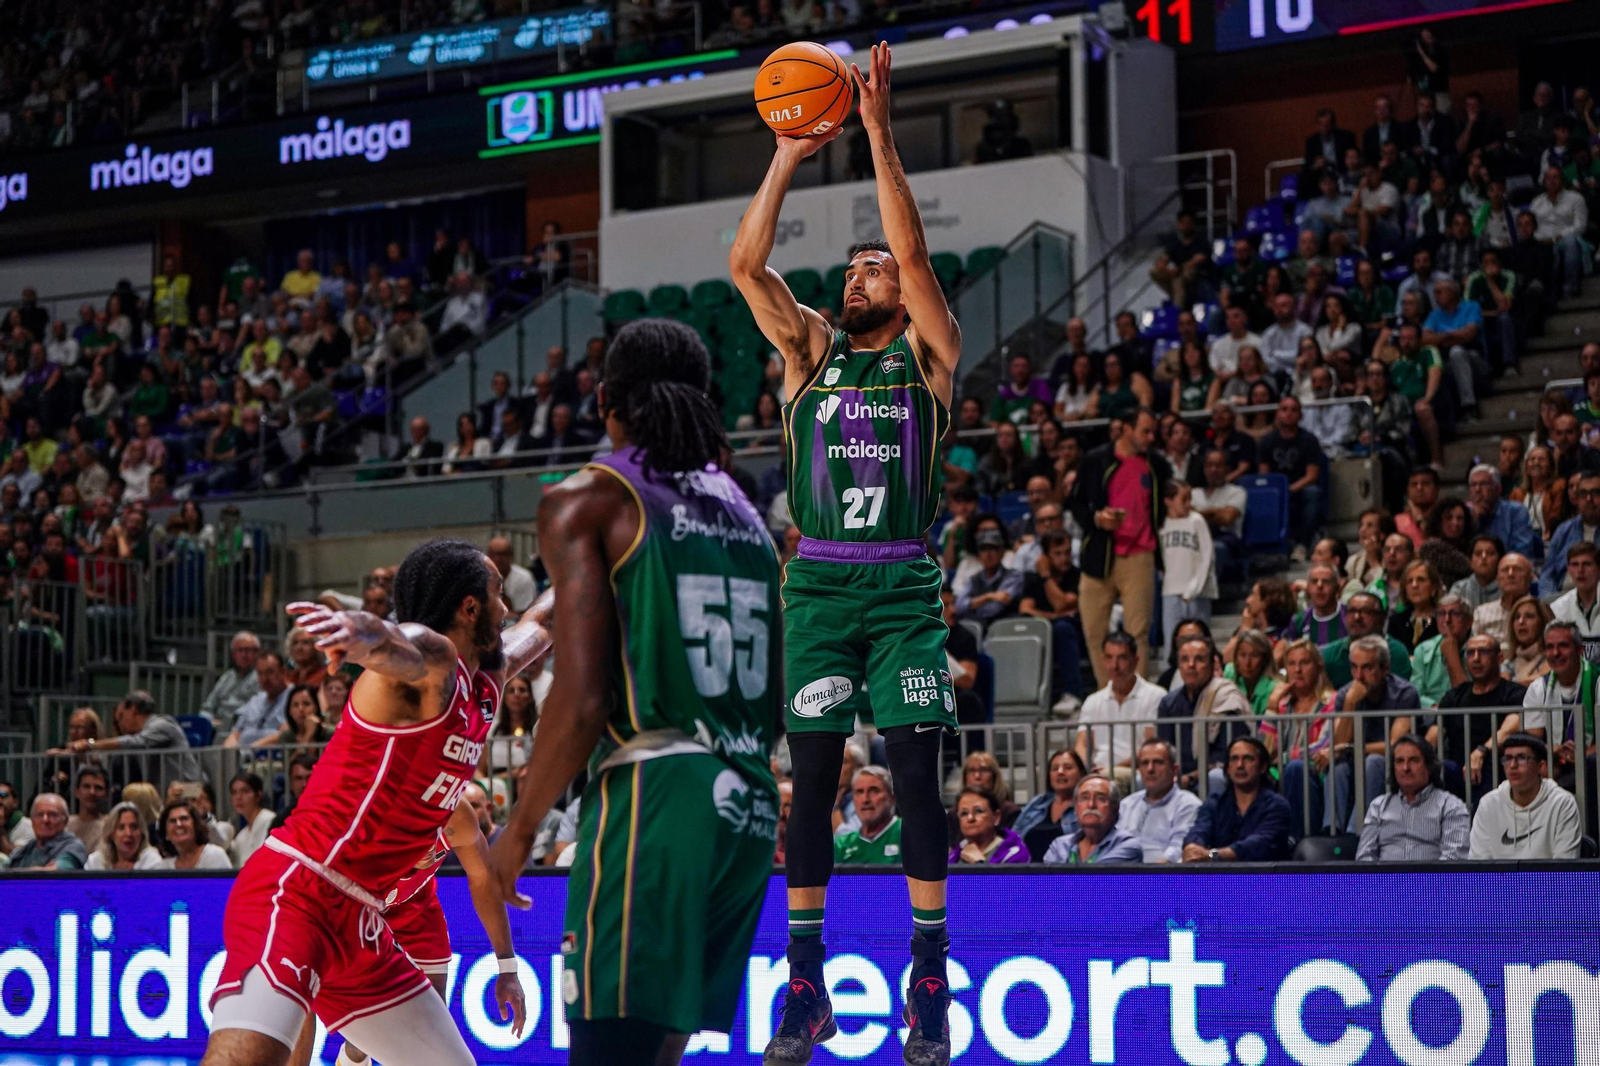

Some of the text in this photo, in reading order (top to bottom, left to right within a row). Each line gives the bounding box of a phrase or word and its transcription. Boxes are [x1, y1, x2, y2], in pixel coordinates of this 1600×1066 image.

[1136, 0, 1192, 44] 11
[845, 401, 909, 424] Unicaja
[842, 486, 886, 529] 27
[676, 573, 769, 700] 55
[900, 667, 925, 678] sabor
[799, 679, 851, 712] famadesa
[903, 687, 939, 707] laga
